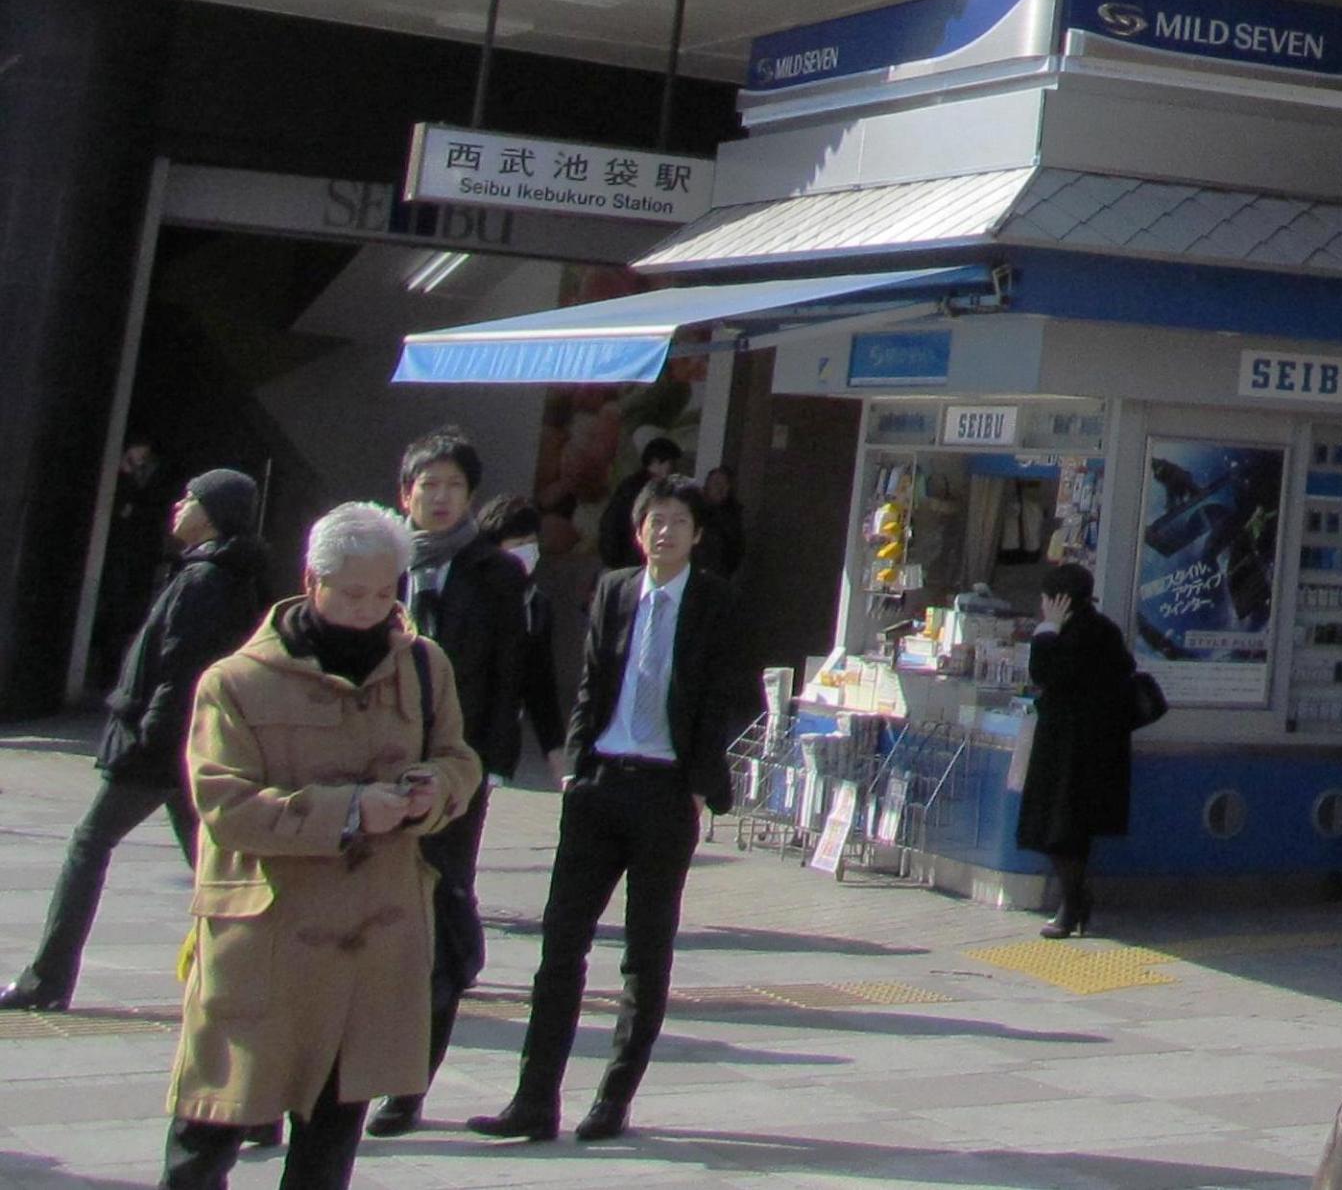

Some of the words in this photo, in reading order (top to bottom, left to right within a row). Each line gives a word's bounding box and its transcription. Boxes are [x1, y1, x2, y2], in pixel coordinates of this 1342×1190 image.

[1155, 11, 1230, 46] MILD
[1233, 24, 1325, 60] SEVEN
[774, 53, 803, 80] MILD
[803, 46, 840, 75] SEVEN
[446, 141, 692, 194] 西武池袋駅
[460, 177, 511, 199] Seibu
[517, 182, 607, 208] Ikebukuro
[612, 192, 674, 215] Station
[957, 411, 1006, 440] SEIBU
